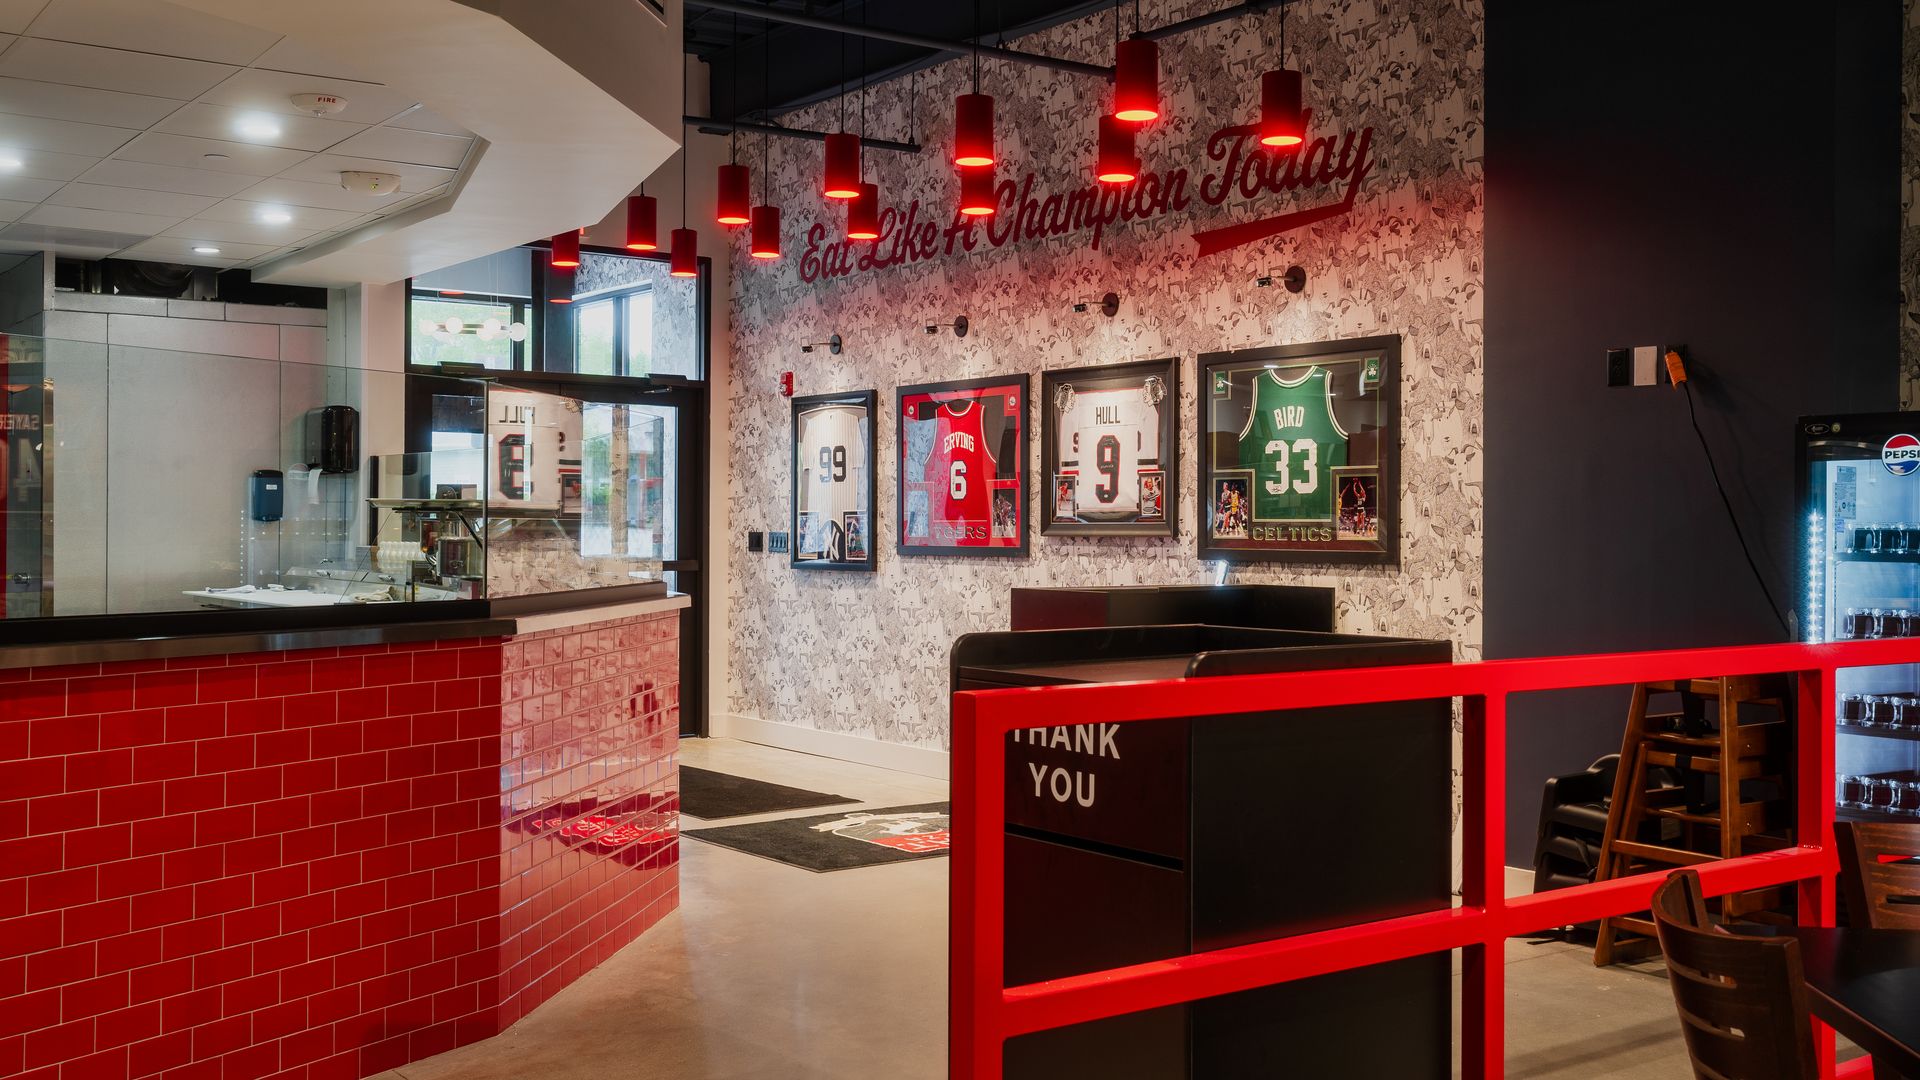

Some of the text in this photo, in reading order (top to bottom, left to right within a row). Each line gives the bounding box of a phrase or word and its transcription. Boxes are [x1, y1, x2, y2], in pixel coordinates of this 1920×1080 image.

[317, 96, 337, 104] FIRE
[800, 222, 855, 284] Eat
[857, 199, 939, 272] Like
[986, 158, 1191, 250] Champion
[1199, 107, 1376, 212] Today
[1095, 404, 1121, 425] HULL
[1273, 405, 1305, 431] BIRD
[943, 431, 975, 455] ERVING
[1884, 449, 1920, 460] PEPSI
[819, 445, 847, 482] 99
[1095, 434, 1121, 504] 9
[1264, 438, 1318, 495] 33
[950, 460, 967, 500] 6
[1252, 525, 1333, 543] CELTICS
[1028, 762, 1095, 808] YOU
